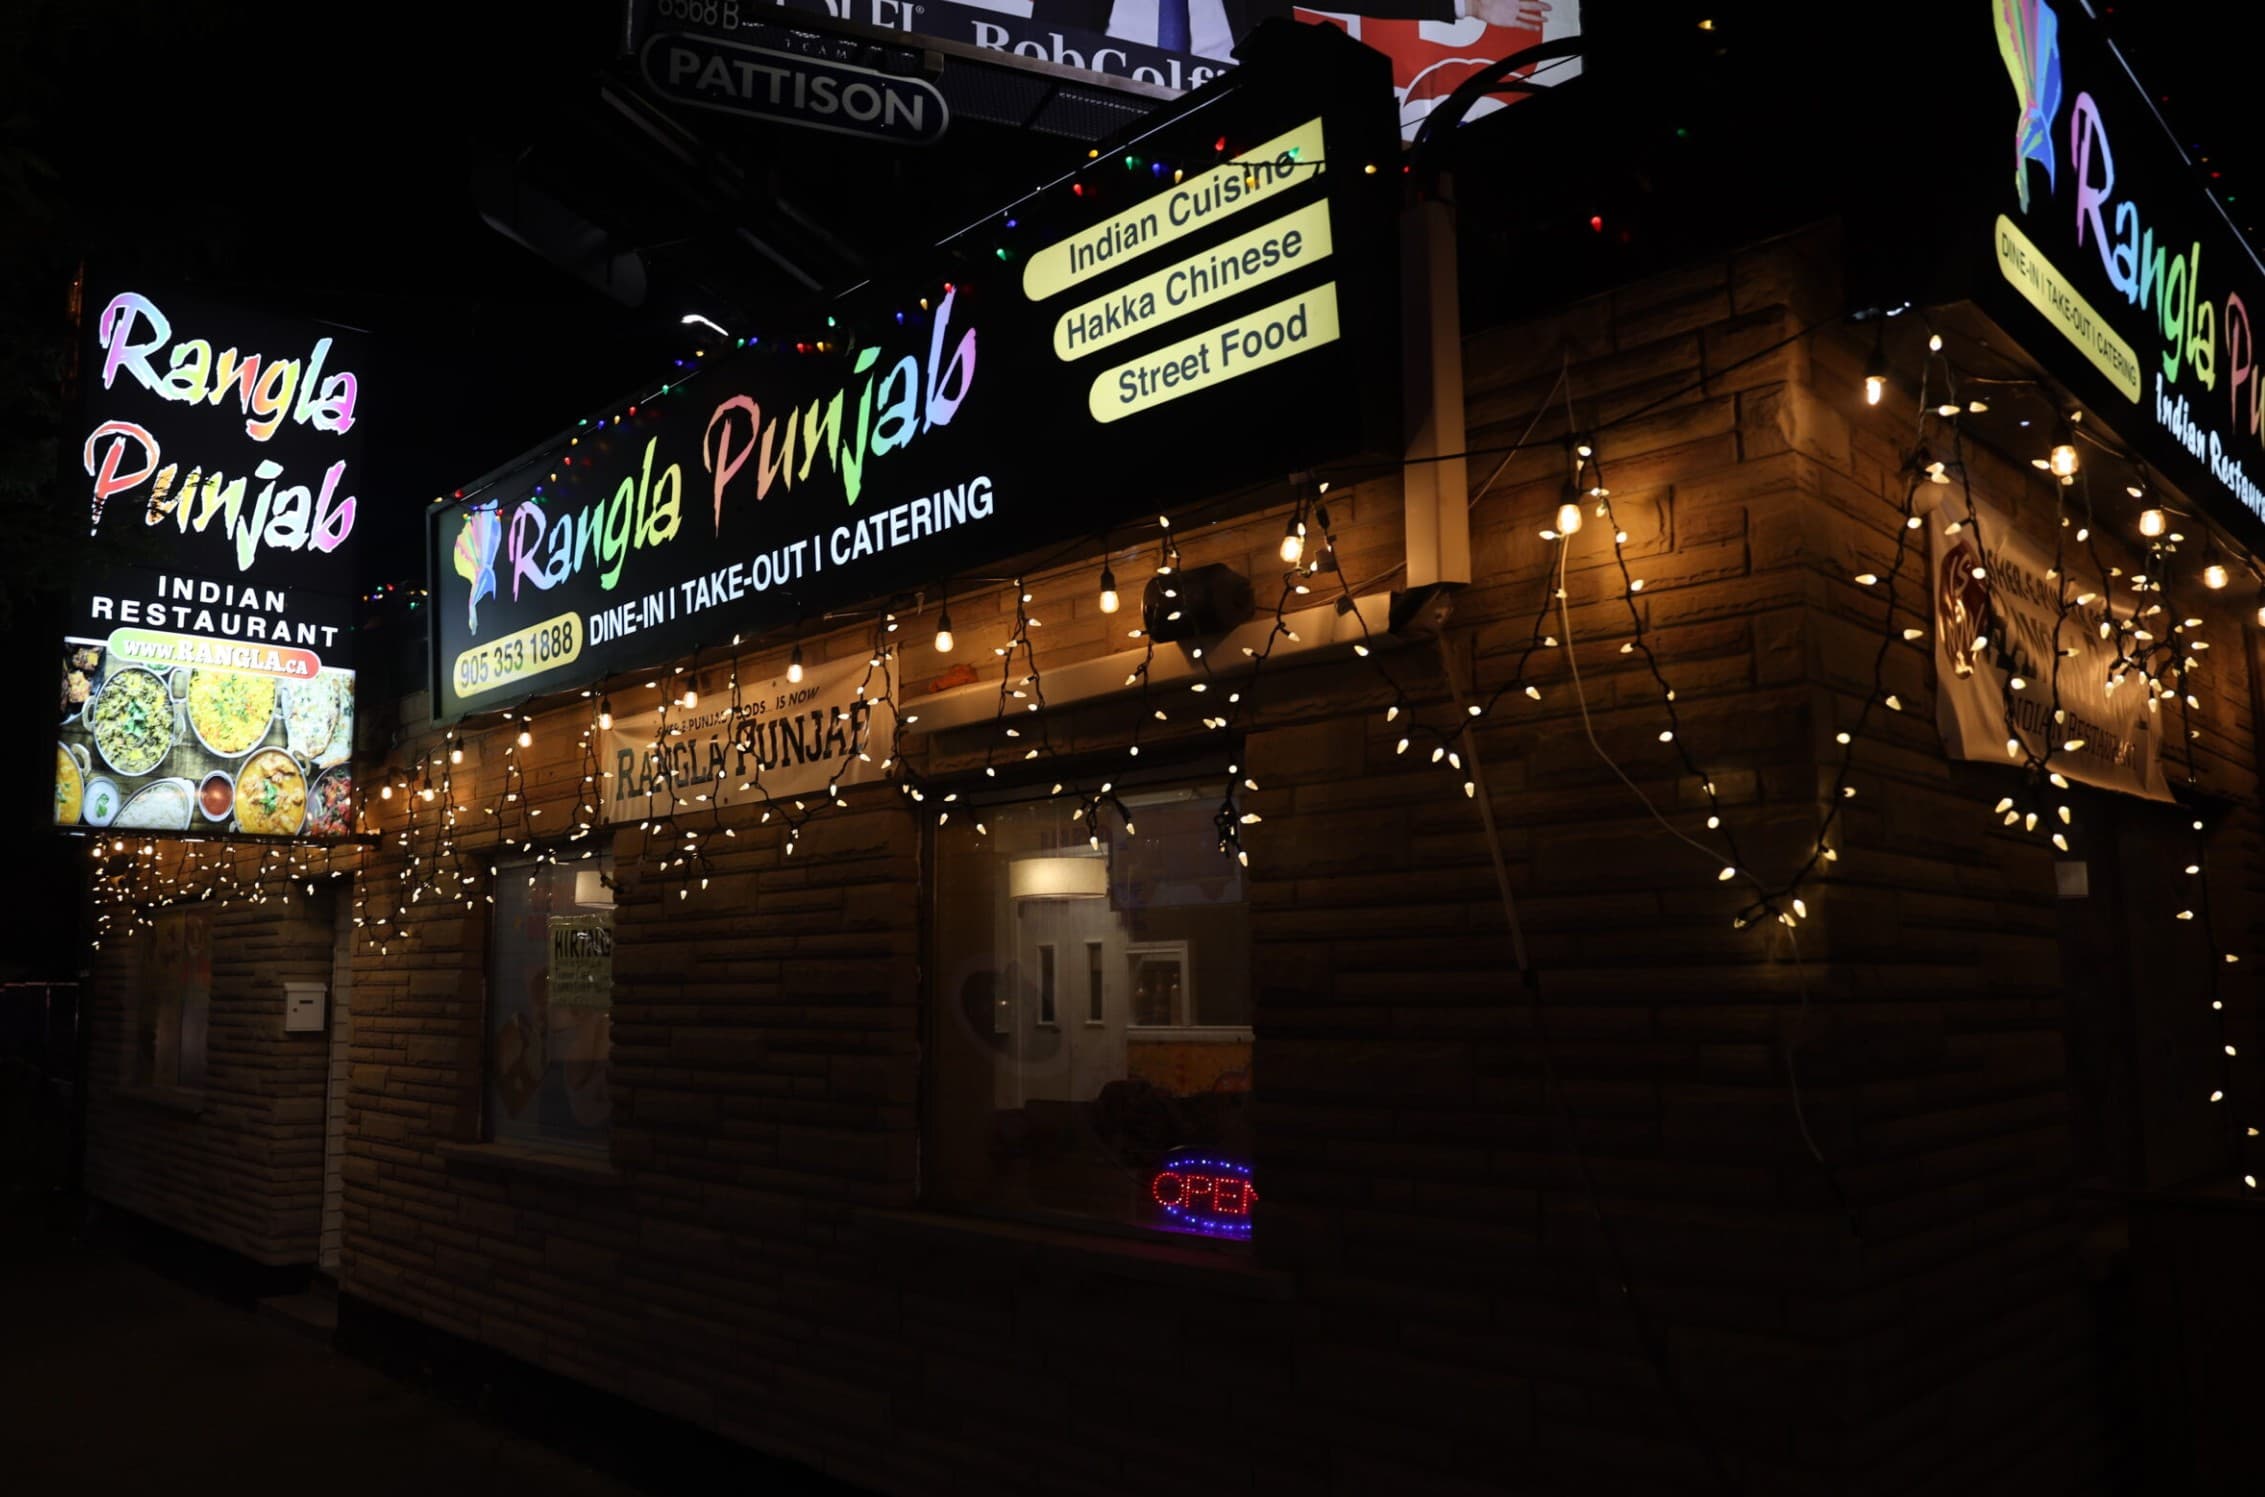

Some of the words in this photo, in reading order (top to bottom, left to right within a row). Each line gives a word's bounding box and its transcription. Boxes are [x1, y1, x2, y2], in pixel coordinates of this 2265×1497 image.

[669, 47, 924, 131] PATTISON
[1069, 212, 1158, 274] Indian
[1168, 150, 1295, 227] Cuisine
[2071, 91, 2216, 392] Rangla
[1067, 291, 1156, 349] Hakka
[1165, 228, 1303, 306] Chinese
[99, 291, 358, 442] Rangla
[1119, 344, 1210, 403] Street
[1221, 303, 1309, 367] Food
[2097, 332, 2138, 387] CATERING
[508, 435, 683, 603] Rangla
[703, 285, 977, 538] Punjab
[2156, 371, 2206, 464] Indian
[83, 420, 357, 572] Punjab
[158, 575, 286, 614] INDIAN
[590, 591, 665, 646] DINE-IN
[681, 539, 809, 616] TAKE-OUT
[829, 475, 995, 566] CATERING
[91, 596, 339, 648] RESTAURANT
[460, 652, 489, 689] 905
[493, 639, 525, 678] 353
[530, 621, 574, 664] 1888
[776, 695, 786, 710] IS
[788, 686, 820, 706] NOW
